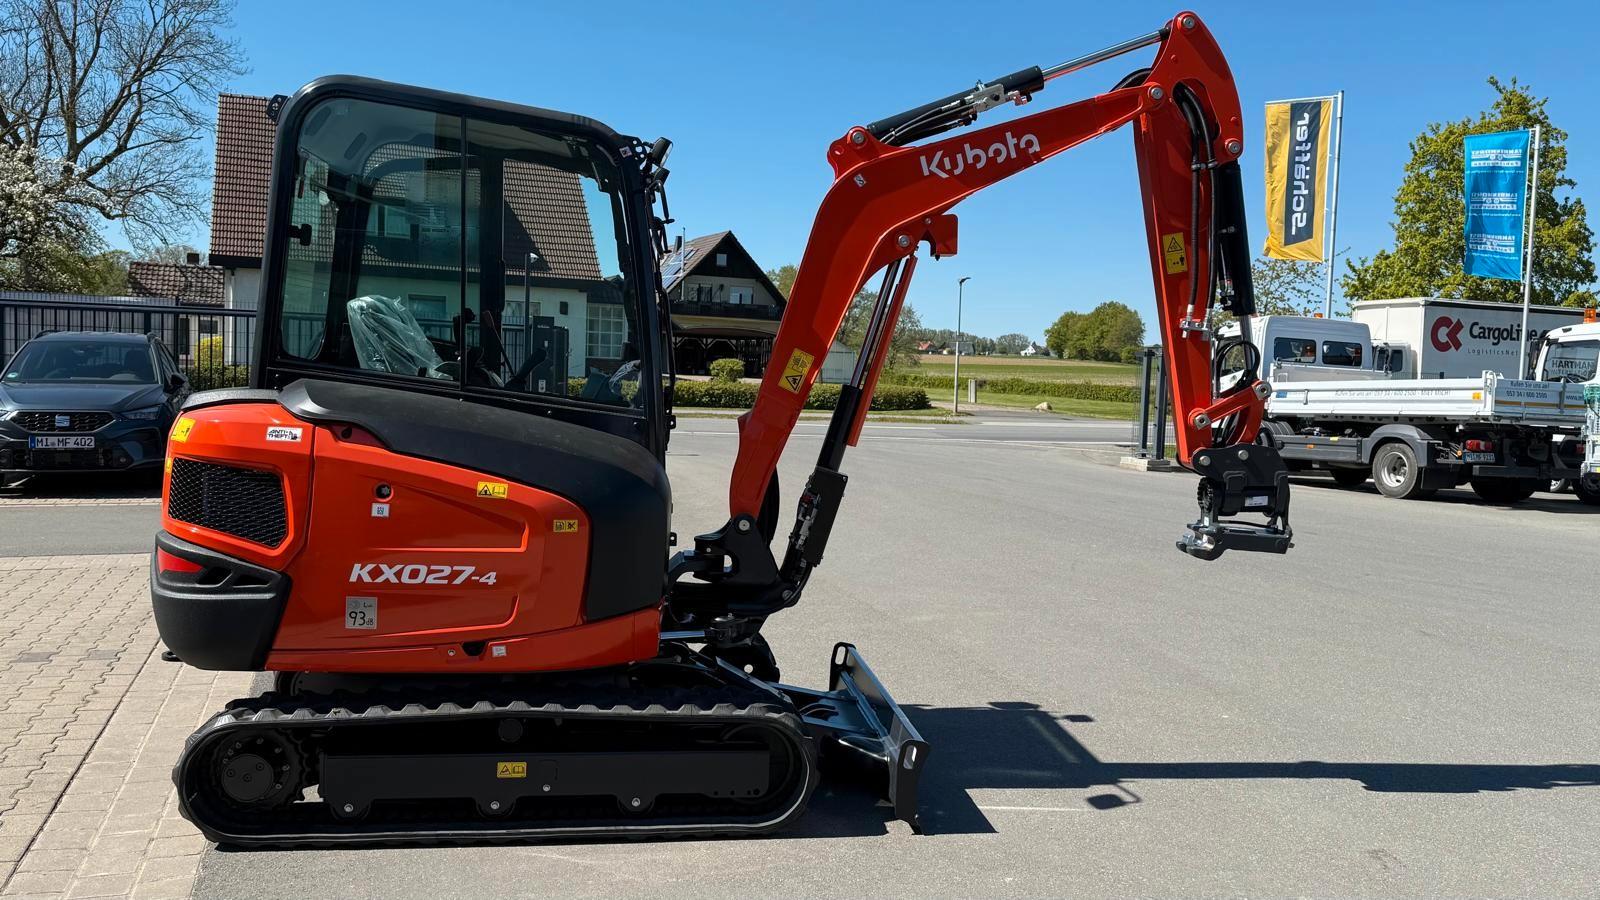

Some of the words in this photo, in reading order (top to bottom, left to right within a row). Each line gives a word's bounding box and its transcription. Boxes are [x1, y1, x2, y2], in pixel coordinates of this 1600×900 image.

[920, 131, 1040, 179] Kubota
[36, 437, 50, 447] MI
[57, 437, 71, 447] MF
[73, 437, 93, 447] 402
[349, 563, 497, 585] KX027-4
[349, 611, 366, 626] 93
[366, 617, 374, 626] dB
